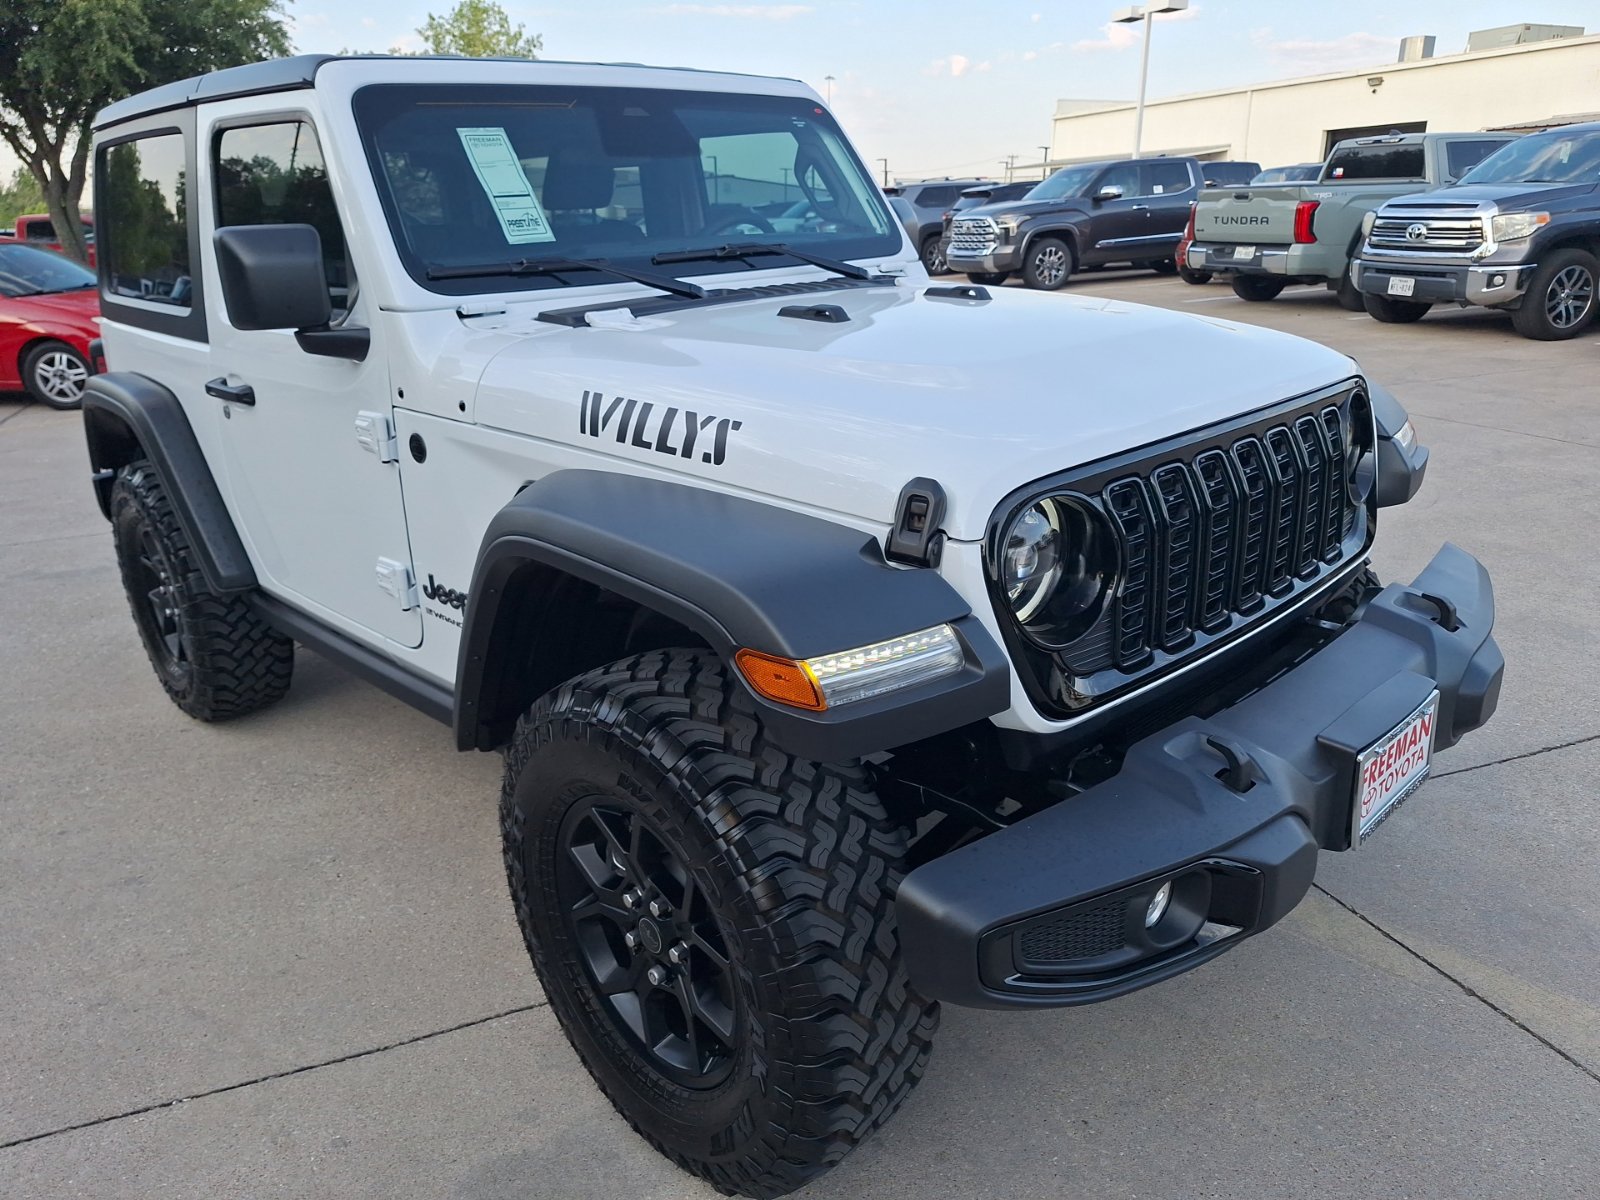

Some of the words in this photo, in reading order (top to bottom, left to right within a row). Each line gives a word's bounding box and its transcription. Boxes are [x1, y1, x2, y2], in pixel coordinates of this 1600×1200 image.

[1214, 216, 1270, 225] TUNDRA
[580, 390, 743, 466] WILLYS
[423, 572, 467, 618] Jeep
[1363, 713, 1433, 790] FREEMAN
[1378, 746, 1424, 799] TOYOTA
